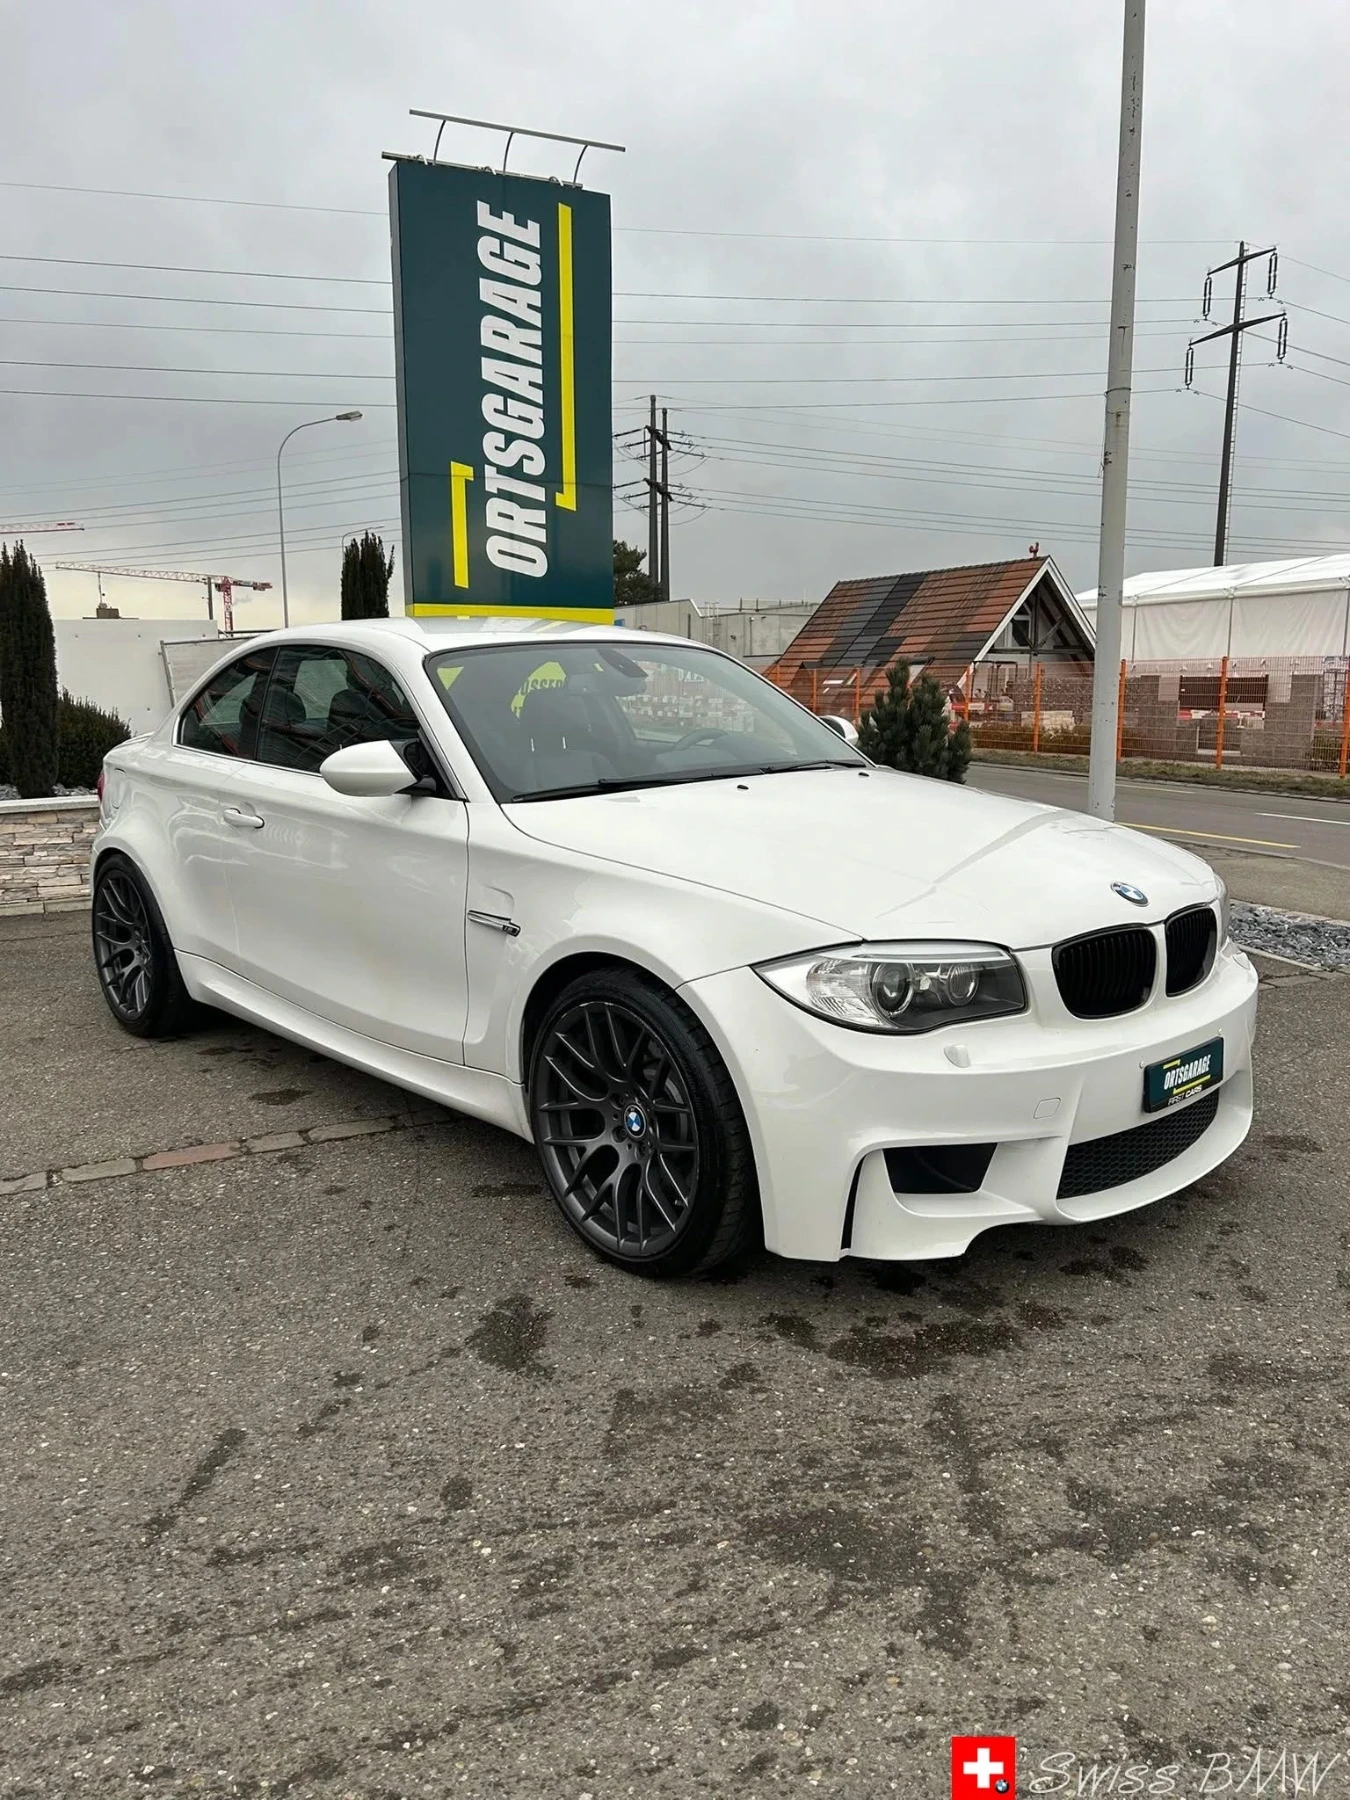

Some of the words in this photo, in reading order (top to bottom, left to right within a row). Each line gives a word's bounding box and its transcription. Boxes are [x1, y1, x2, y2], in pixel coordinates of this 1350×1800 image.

[476, 199, 549, 578] ORTSGARAGE
[1163, 1054, 1211, 1090] ORTSGARAGE
[1168, 1092, 1185, 1105] FIRST
[1185, 1085, 1202, 1097] CARS
